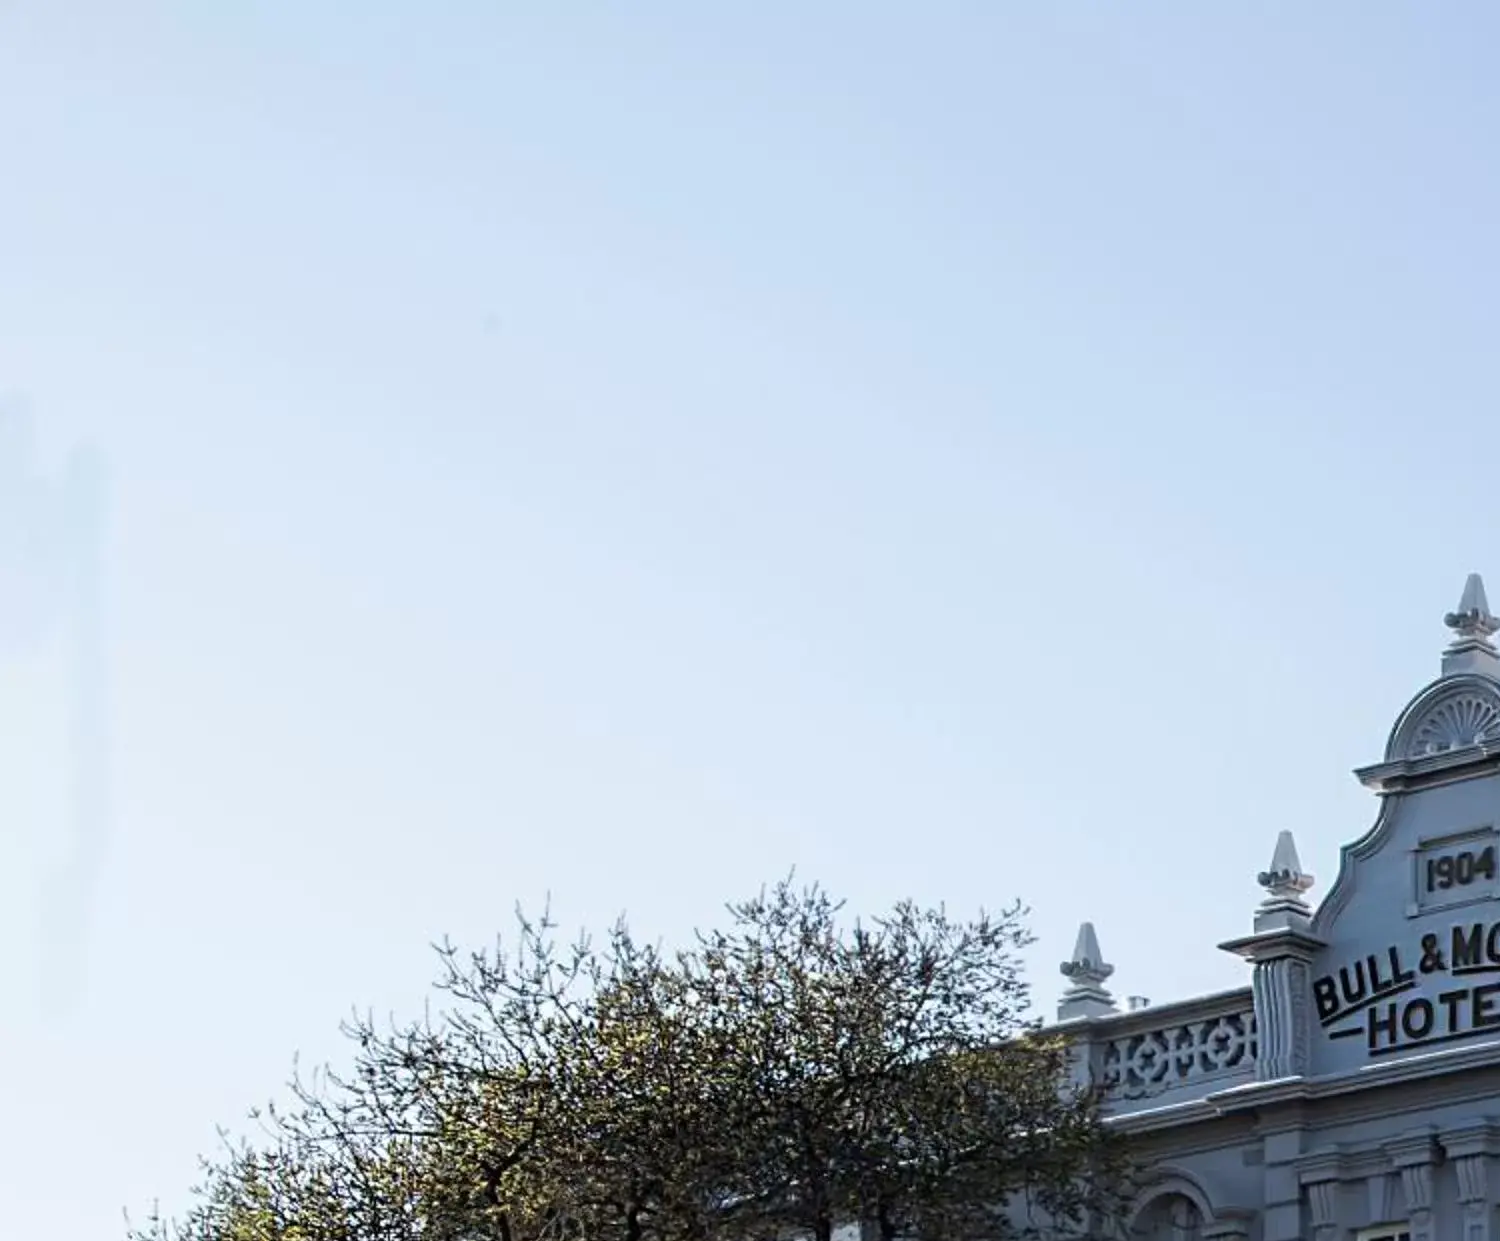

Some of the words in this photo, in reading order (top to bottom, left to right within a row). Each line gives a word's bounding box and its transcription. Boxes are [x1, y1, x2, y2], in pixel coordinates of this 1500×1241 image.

[1426, 846, 1495, 892] 1904
[1313, 946, 1415, 1021] BULL
[1419, 933, 1449, 974] &
